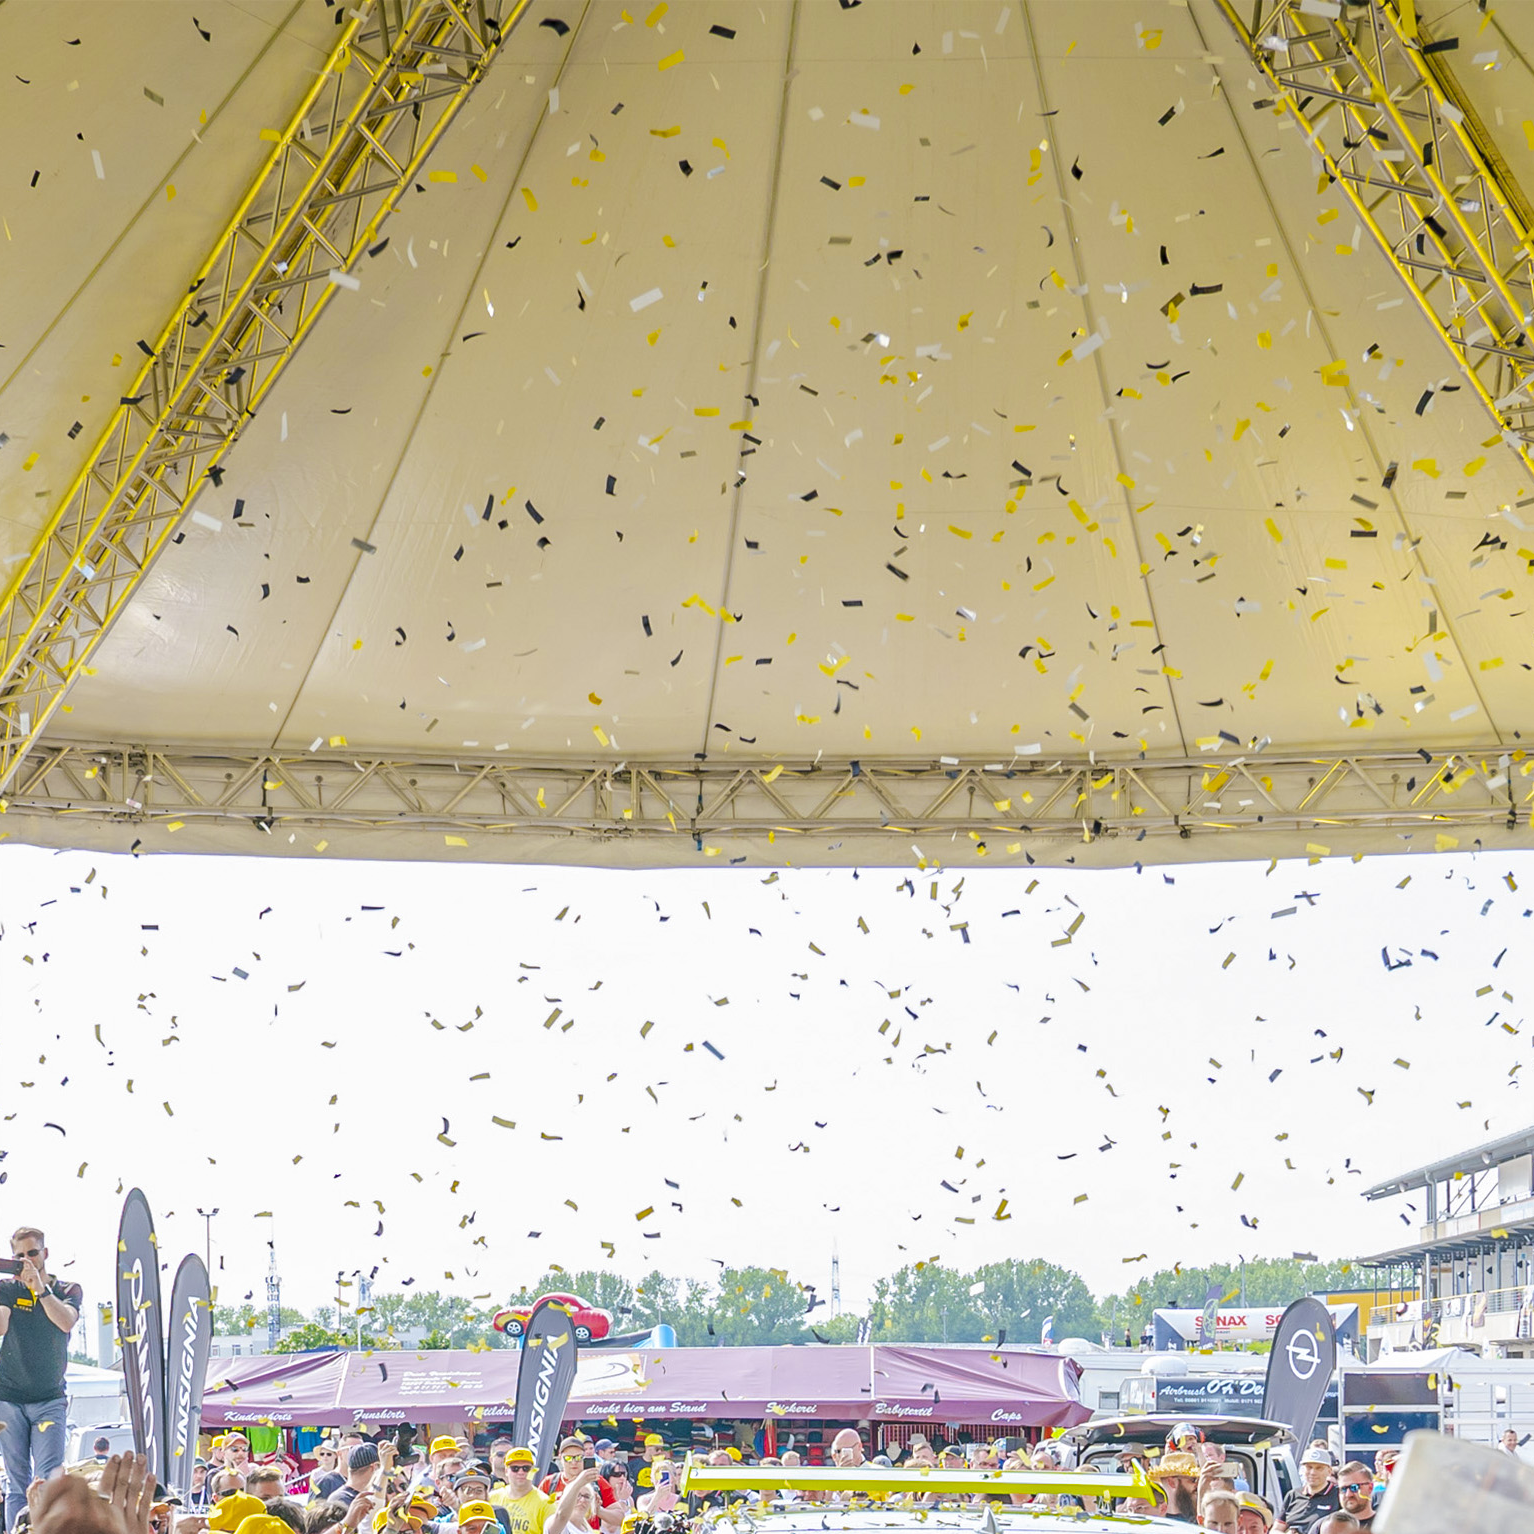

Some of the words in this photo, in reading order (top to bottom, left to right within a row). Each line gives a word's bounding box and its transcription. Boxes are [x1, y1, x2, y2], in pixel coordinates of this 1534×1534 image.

[1194, 1315, 1247, 1327] SNAX
[174, 1295, 201, 1452] INSIGNIA
[526, 1334, 559, 1460] NSIGNIA
[1159, 1385, 1206, 1397] Airbrush
[352, 1408, 406, 1421] Funshirts
[464, 1405, 516, 1417] Tetildru
[586, 1404, 620, 1415] direkt
[622, 1403, 645, 1414] hier
[647, 1405, 667, 1414] am
[669, 1402, 707, 1413] Stand
[874, 1403, 935, 1418] Babytextil
[991, 1408, 1023, 1421] Caps
